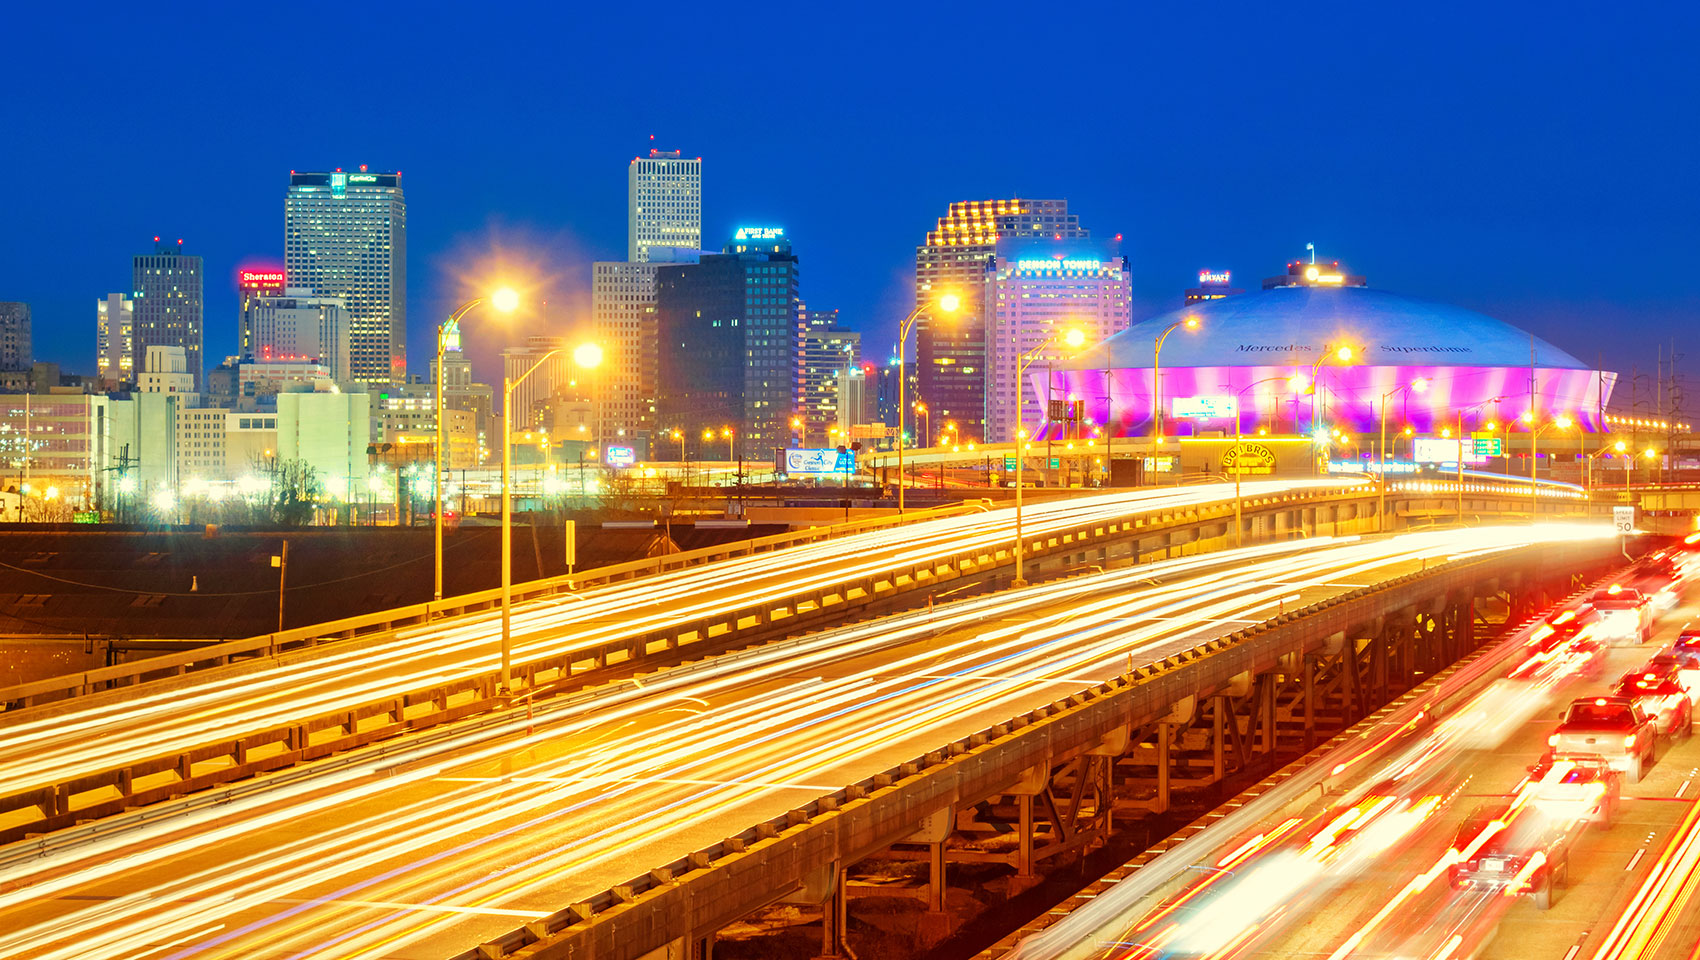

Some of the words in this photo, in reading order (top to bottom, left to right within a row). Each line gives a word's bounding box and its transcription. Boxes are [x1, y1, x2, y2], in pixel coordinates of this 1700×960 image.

[744, 227, 762, 235] FIRST
[763, 227, 784, 235] BANK
[1018, 260, 1061, 270] BENSON
[1063, 260, 1100, 270] TOWER
[243, 272, 283, 281] Sheraton
[1206, 273, 1230, 282] HYATT
[1381, 345, 1473, 353] Superdome
[1246, 444, 1274, 464] BROS
[1616, 522, 1632, 532] 50
